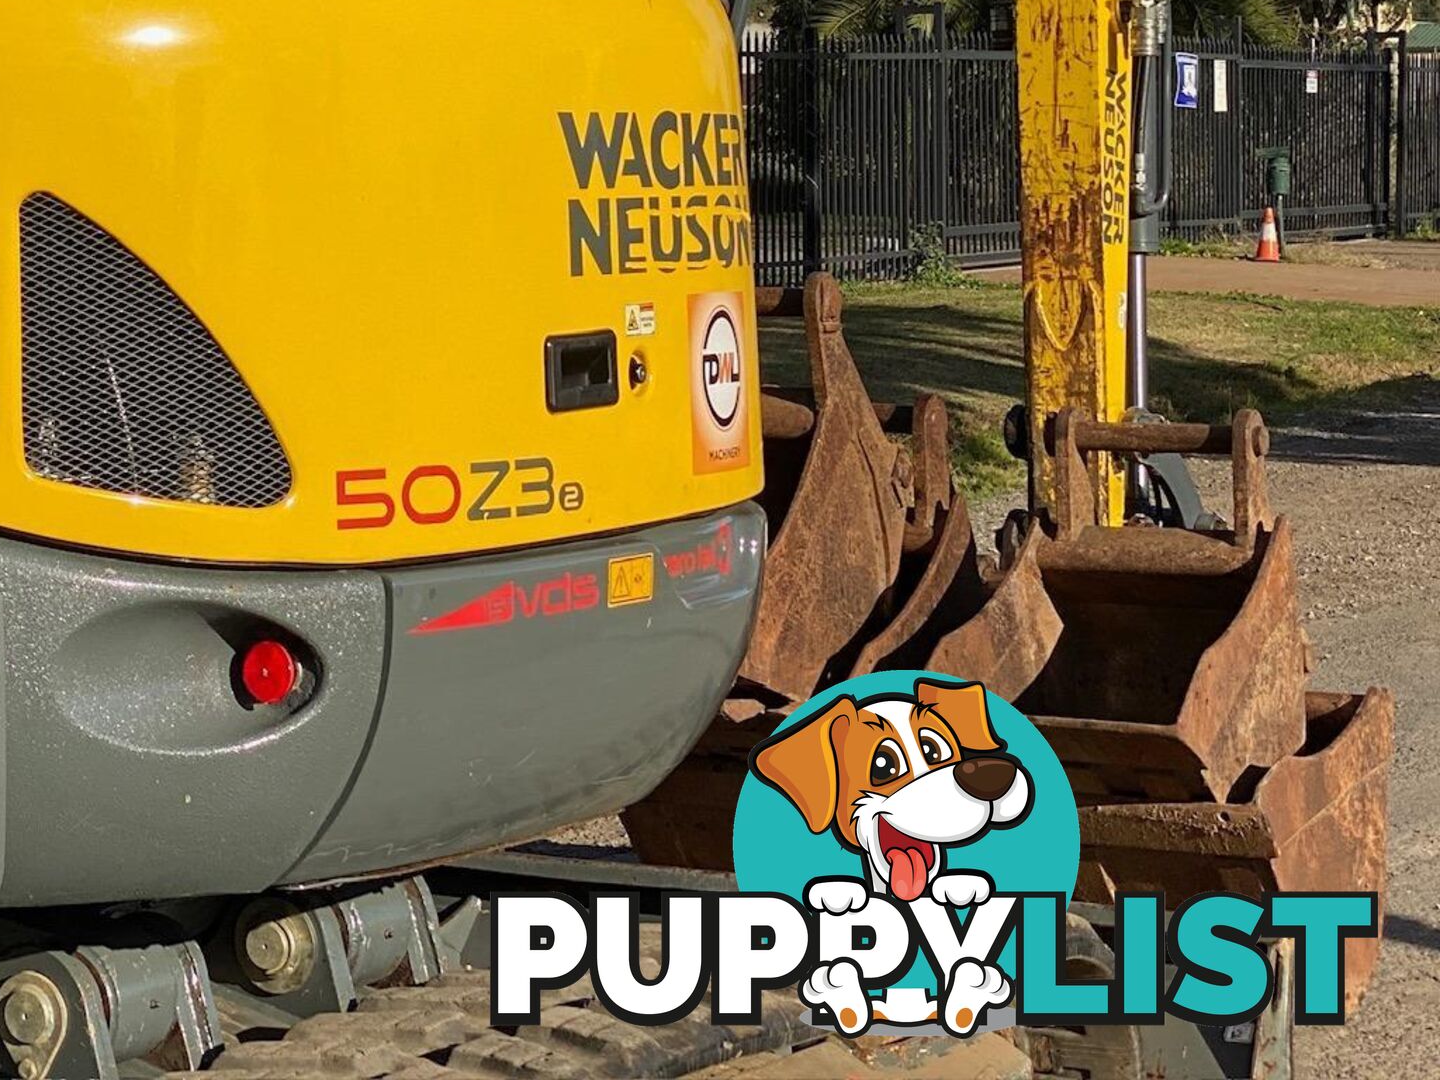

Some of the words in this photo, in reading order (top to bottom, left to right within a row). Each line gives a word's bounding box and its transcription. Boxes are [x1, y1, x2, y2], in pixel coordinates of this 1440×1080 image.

[557, 110, 744, 189] WACKER
[1103, 69, 1117, 245] NEUSON
[1112, 71, 1128, 244] WACKER
[568, 193, 750, 277] NEUSON
